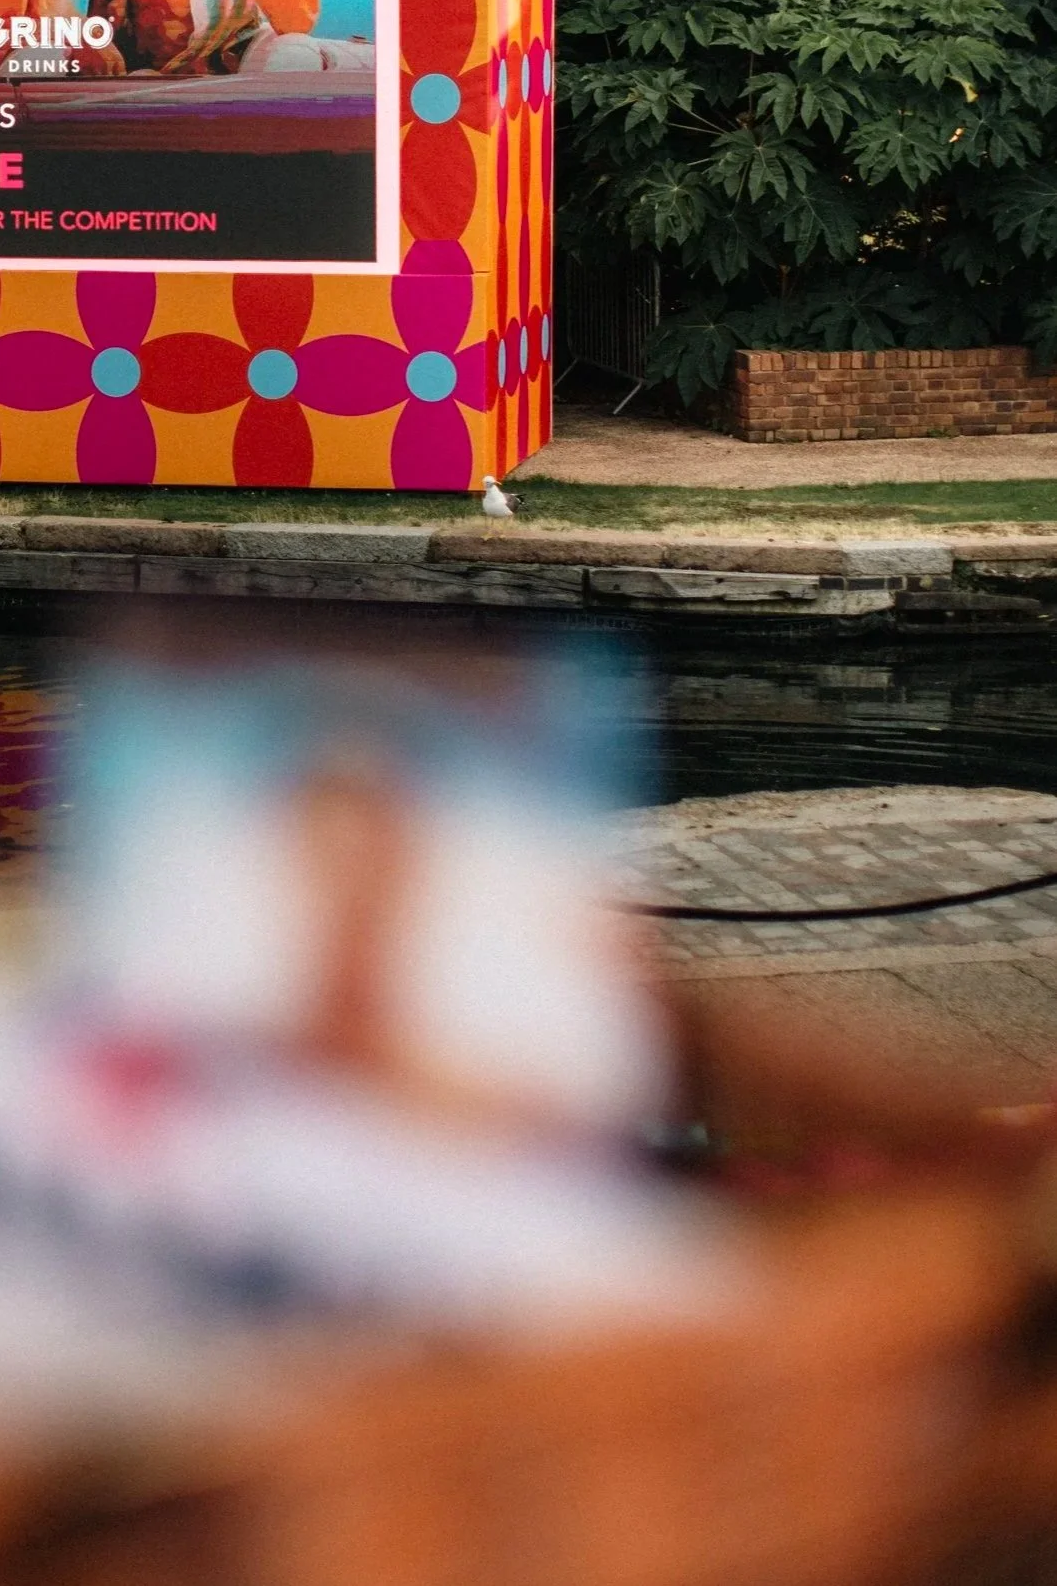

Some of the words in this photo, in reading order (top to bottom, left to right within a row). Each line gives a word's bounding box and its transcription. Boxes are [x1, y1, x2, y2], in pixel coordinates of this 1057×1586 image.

[7, 59, 81, 74] DRINKS
[10, 209, 53, 230] THE
[59, 210, 218, 232] COMPETITION
